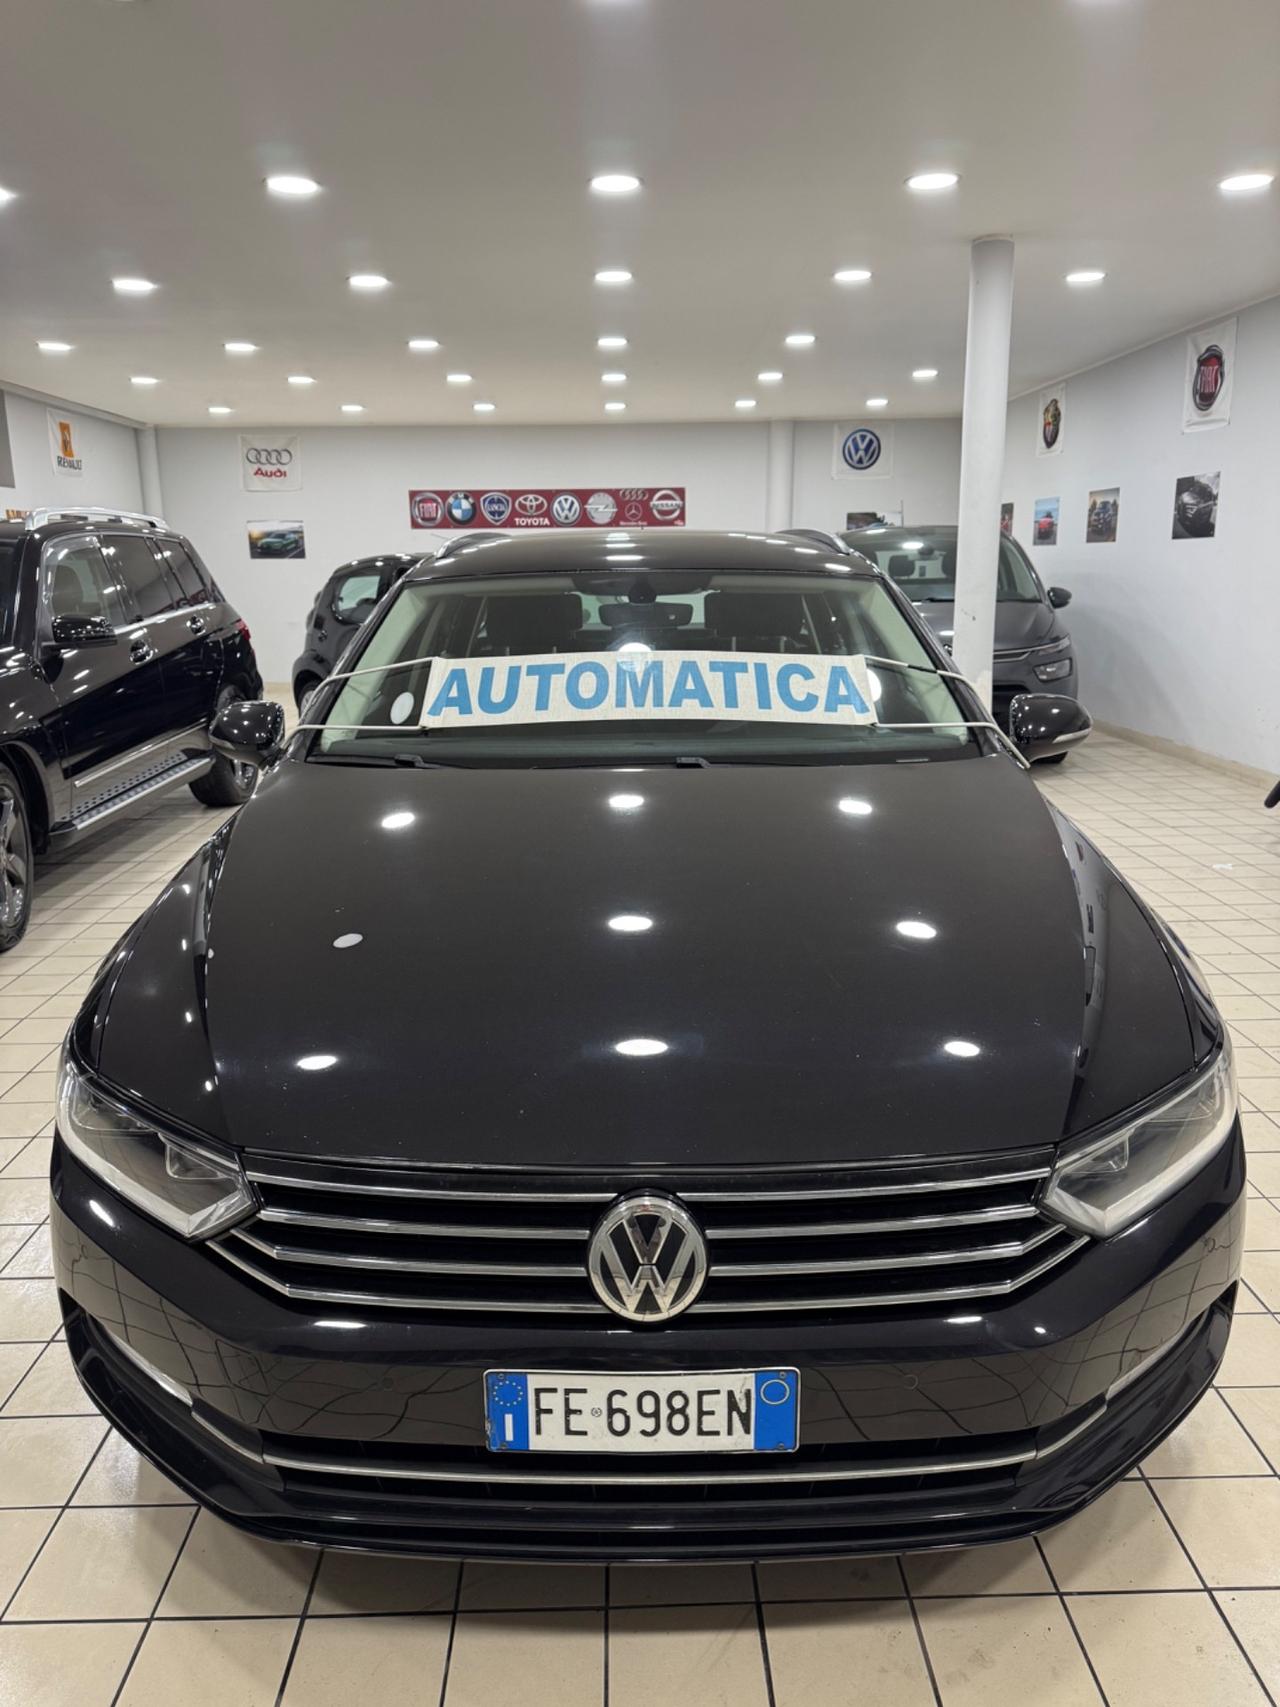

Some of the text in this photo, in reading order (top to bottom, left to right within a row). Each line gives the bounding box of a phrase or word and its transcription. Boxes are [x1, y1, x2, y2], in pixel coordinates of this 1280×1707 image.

[254, 467, 287, 478] Audi
[514, 517, 550, 526] TOYOTA
[427, 661, 869, 716] AUTOMATICA
